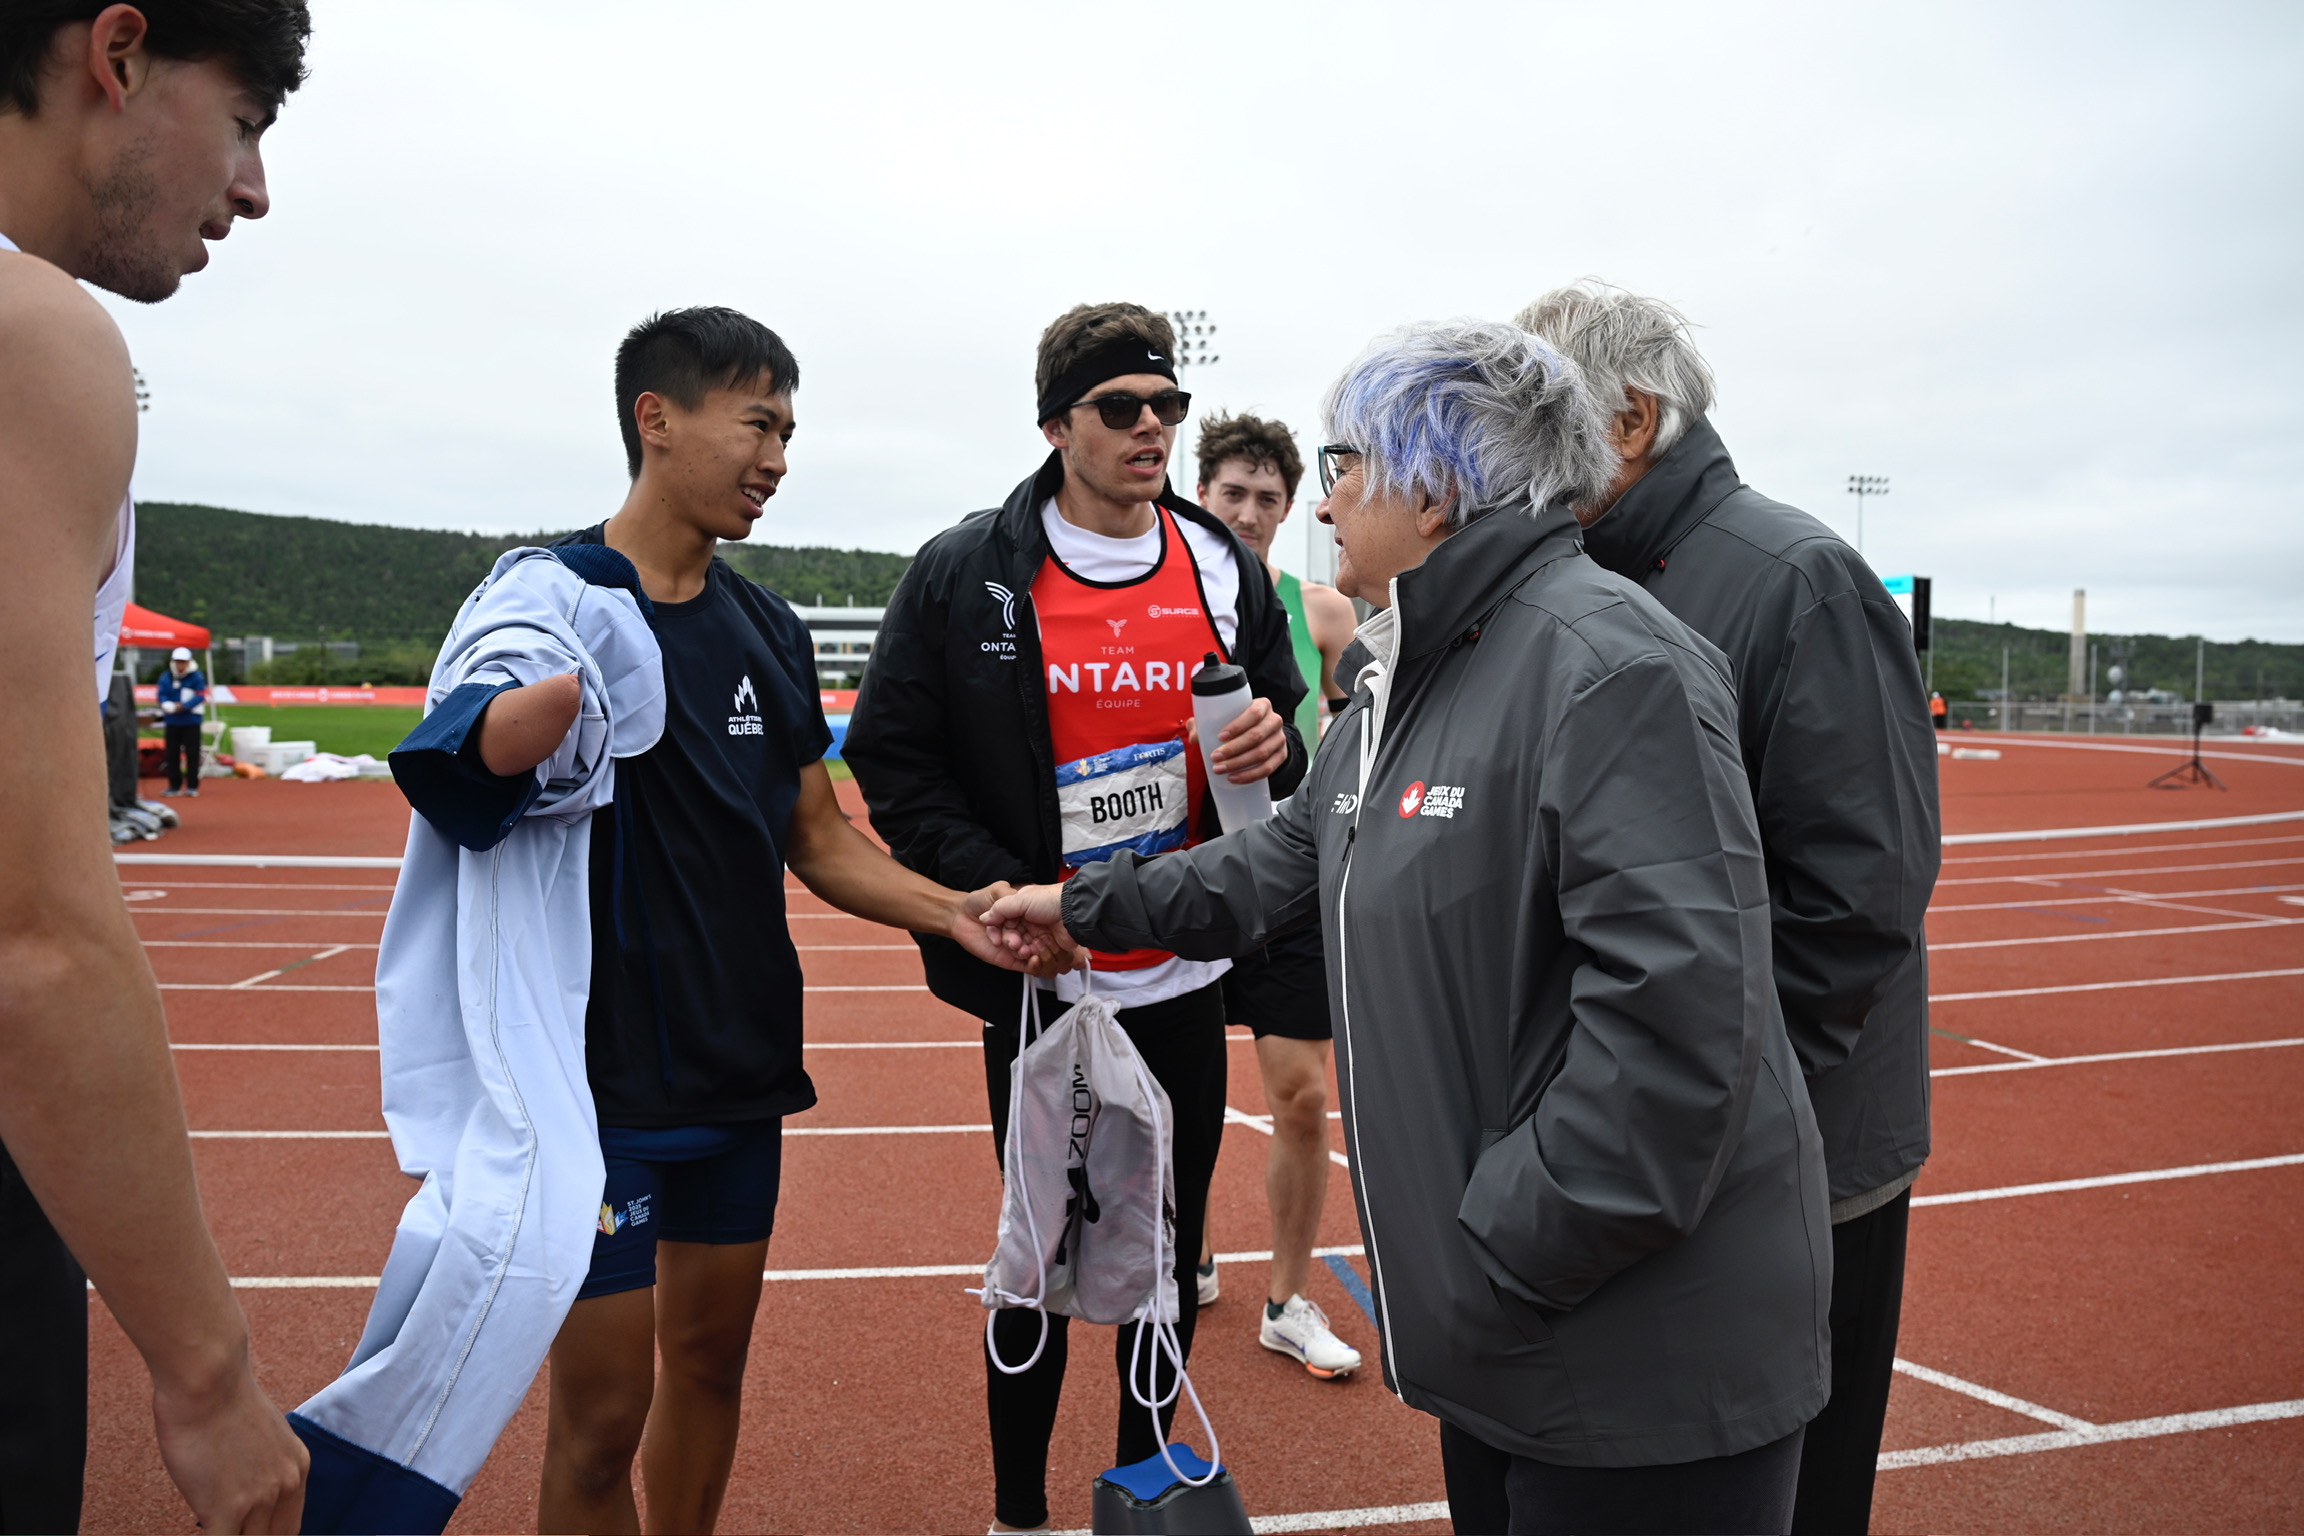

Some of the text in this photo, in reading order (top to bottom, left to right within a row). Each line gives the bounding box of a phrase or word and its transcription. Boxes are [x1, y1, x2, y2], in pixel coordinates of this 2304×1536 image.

[981, 642, 1016, 652] ONTA
[1101, 647, 1135, 655] TEAM
[1049, 661, 1205, 694] NTARI
[1096, 699, 1141, 709] ÉQUIPE
[1133, 747, 1166, 761] FORTIS
[1450, 787, 1466, 798] DU
[1090, 781, 1163, 824] BOOTH
[1423, 795, 1463, 809] CANADA
[1420, 805, 1454, 819] GAMES
[630, 1208, 643, 1217] JEUX
[630, 1216, 649, 1227] GAMES
